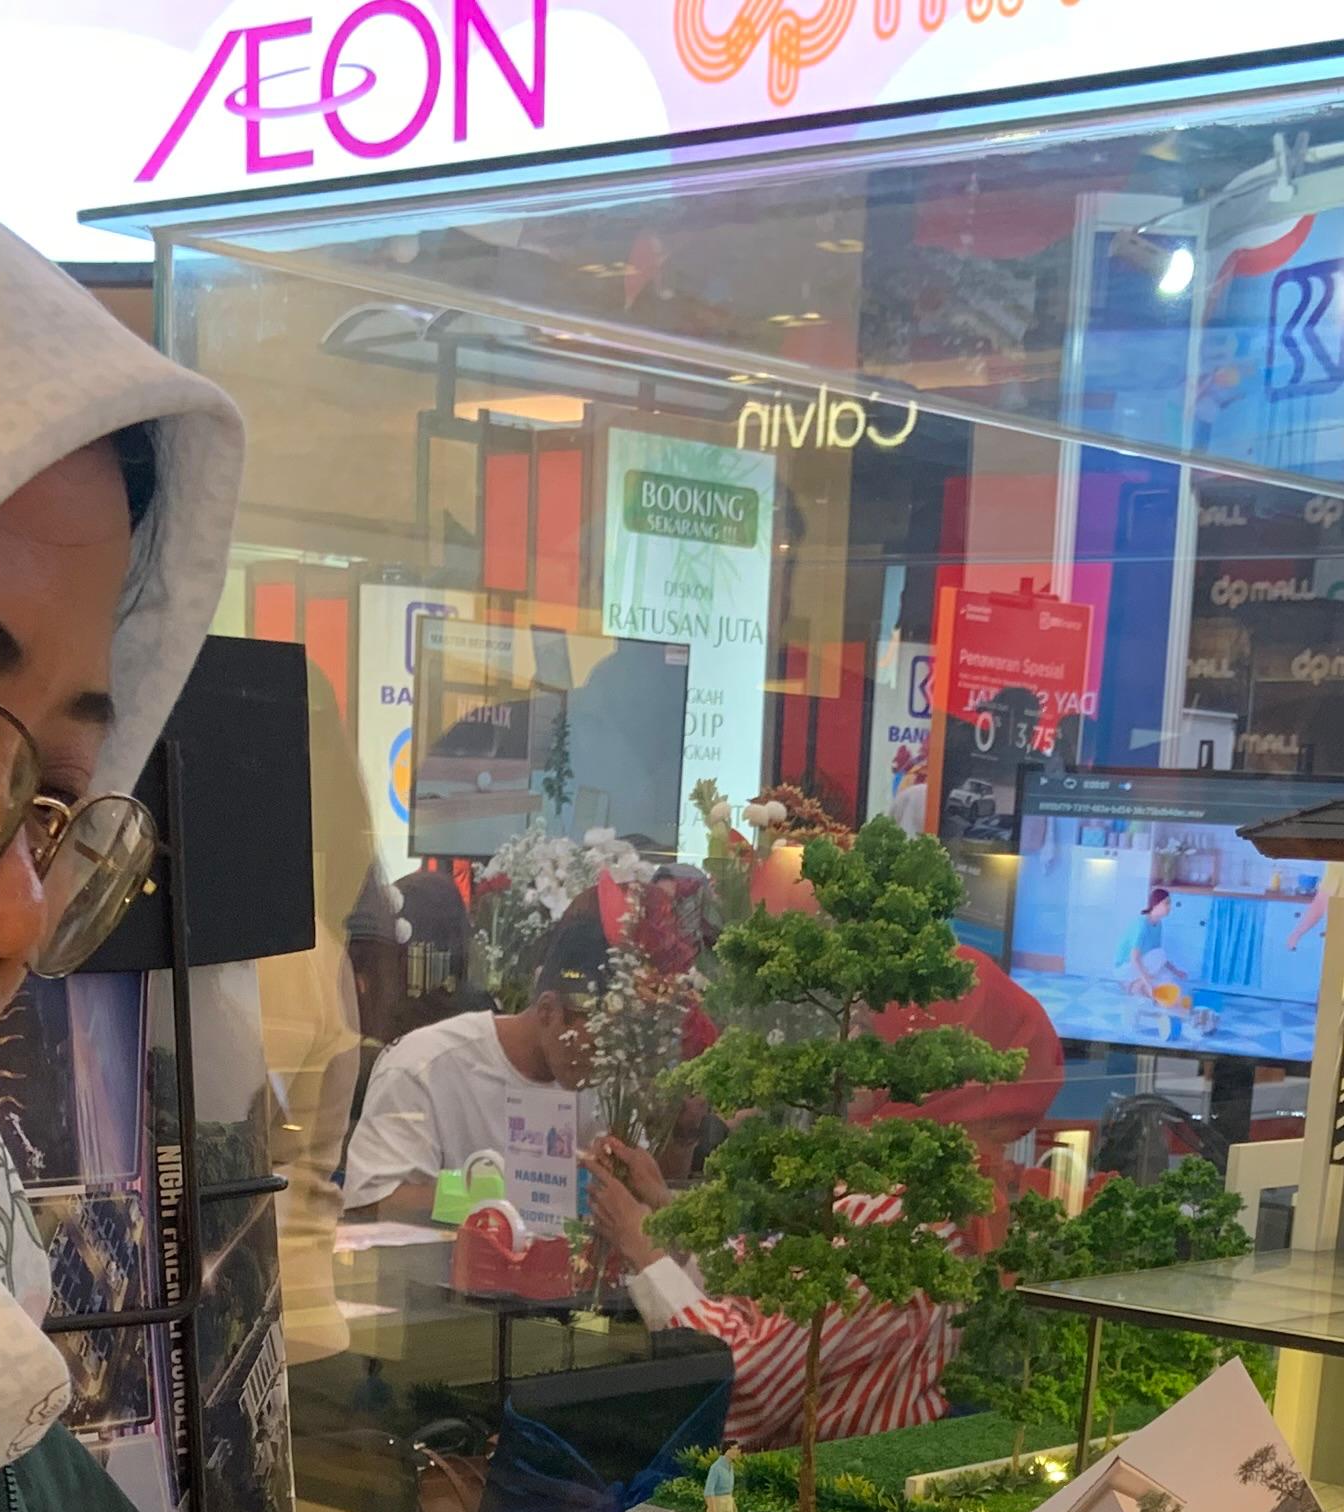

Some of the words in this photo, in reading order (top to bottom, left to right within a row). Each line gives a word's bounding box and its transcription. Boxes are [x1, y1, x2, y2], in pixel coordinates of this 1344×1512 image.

[641, 480, 744, 522] BOOKING
[647, 514, 719, 540] SEKARANG
[664, 581, 714, 600] DISKON
[608, 603, 710, 638] RATUSAN
[714, 616, 764, 647] JUTA
[381, 686, 412, 705] BA
[687, 688, 724, 705] GKAH
[684, 745, 720, 761] GKAH
[515, 1170, 567, 1187] NASABAH
[531, 1191, 550, 1203] BRI
